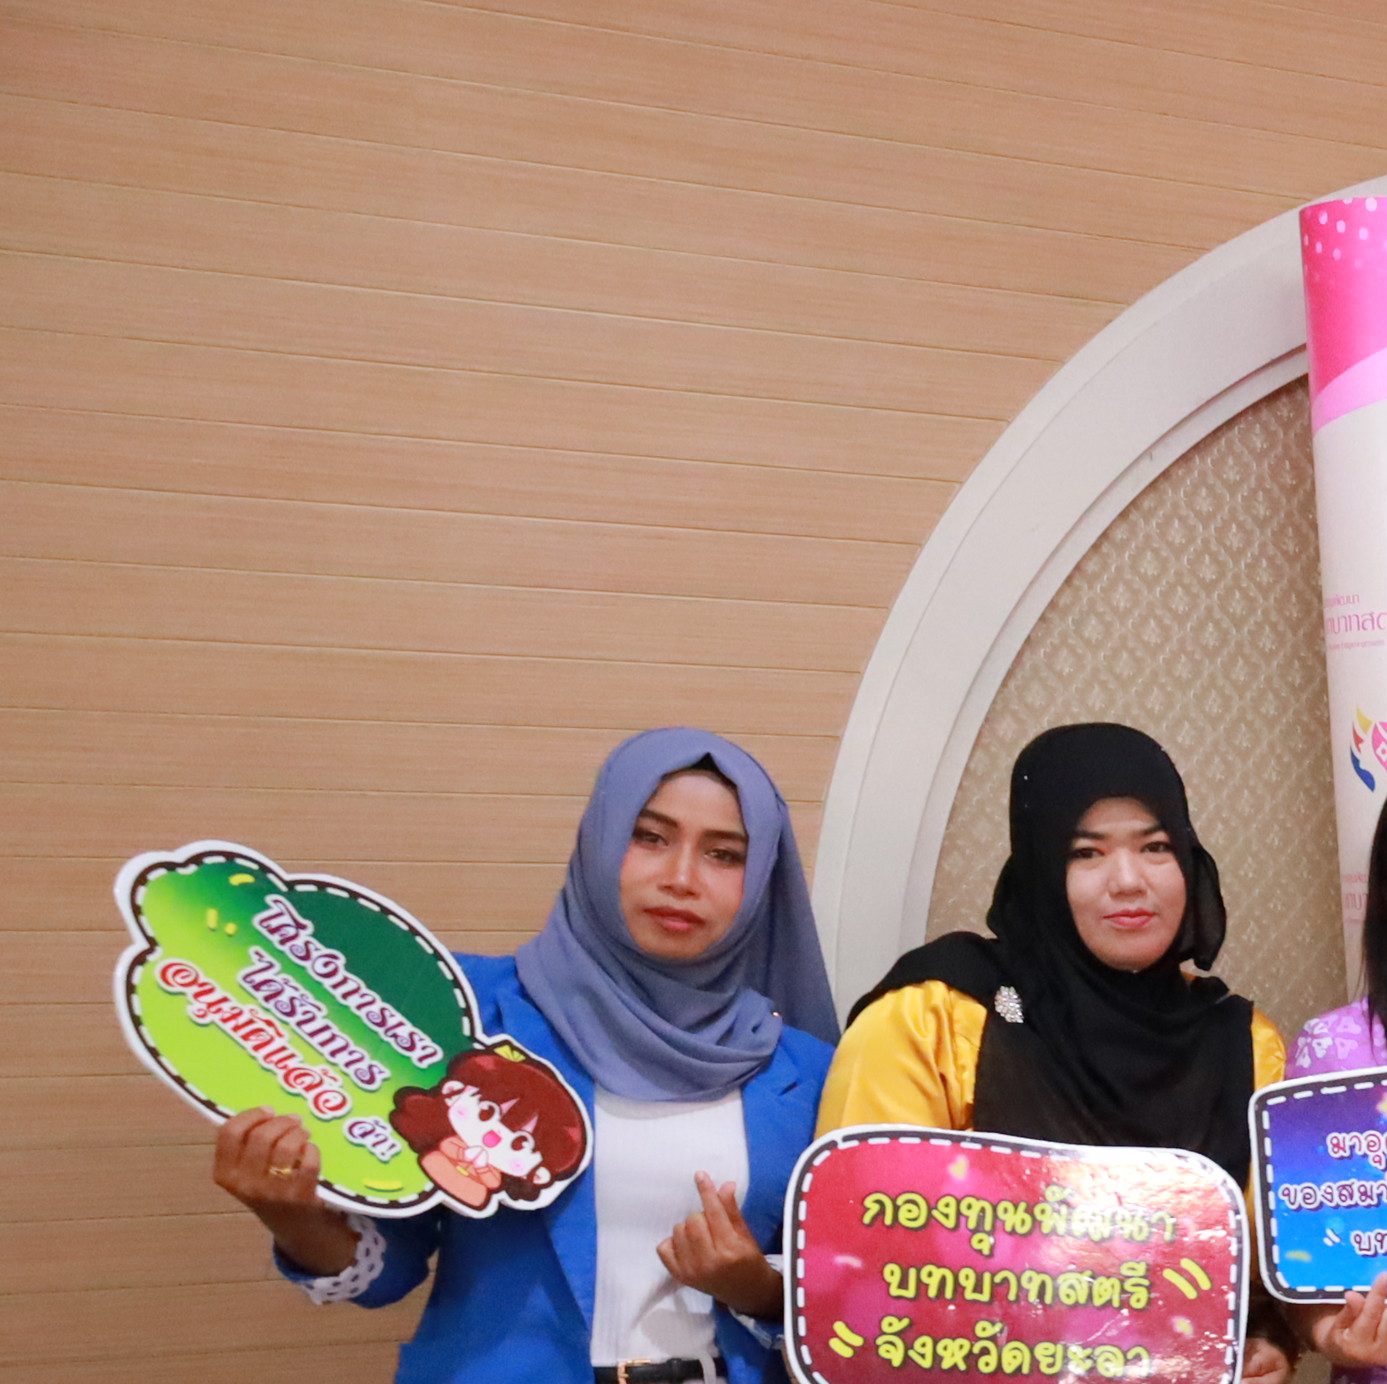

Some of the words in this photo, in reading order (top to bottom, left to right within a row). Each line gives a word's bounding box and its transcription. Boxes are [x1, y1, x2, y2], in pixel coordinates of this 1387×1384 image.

[862, 1185, 1177, 1256] กองทุนพัฒนา
[883, 1260, 1152, 1309] บทบาทสตรี
[875, 1316, 1152, 1378] จังหวัดยะลา
